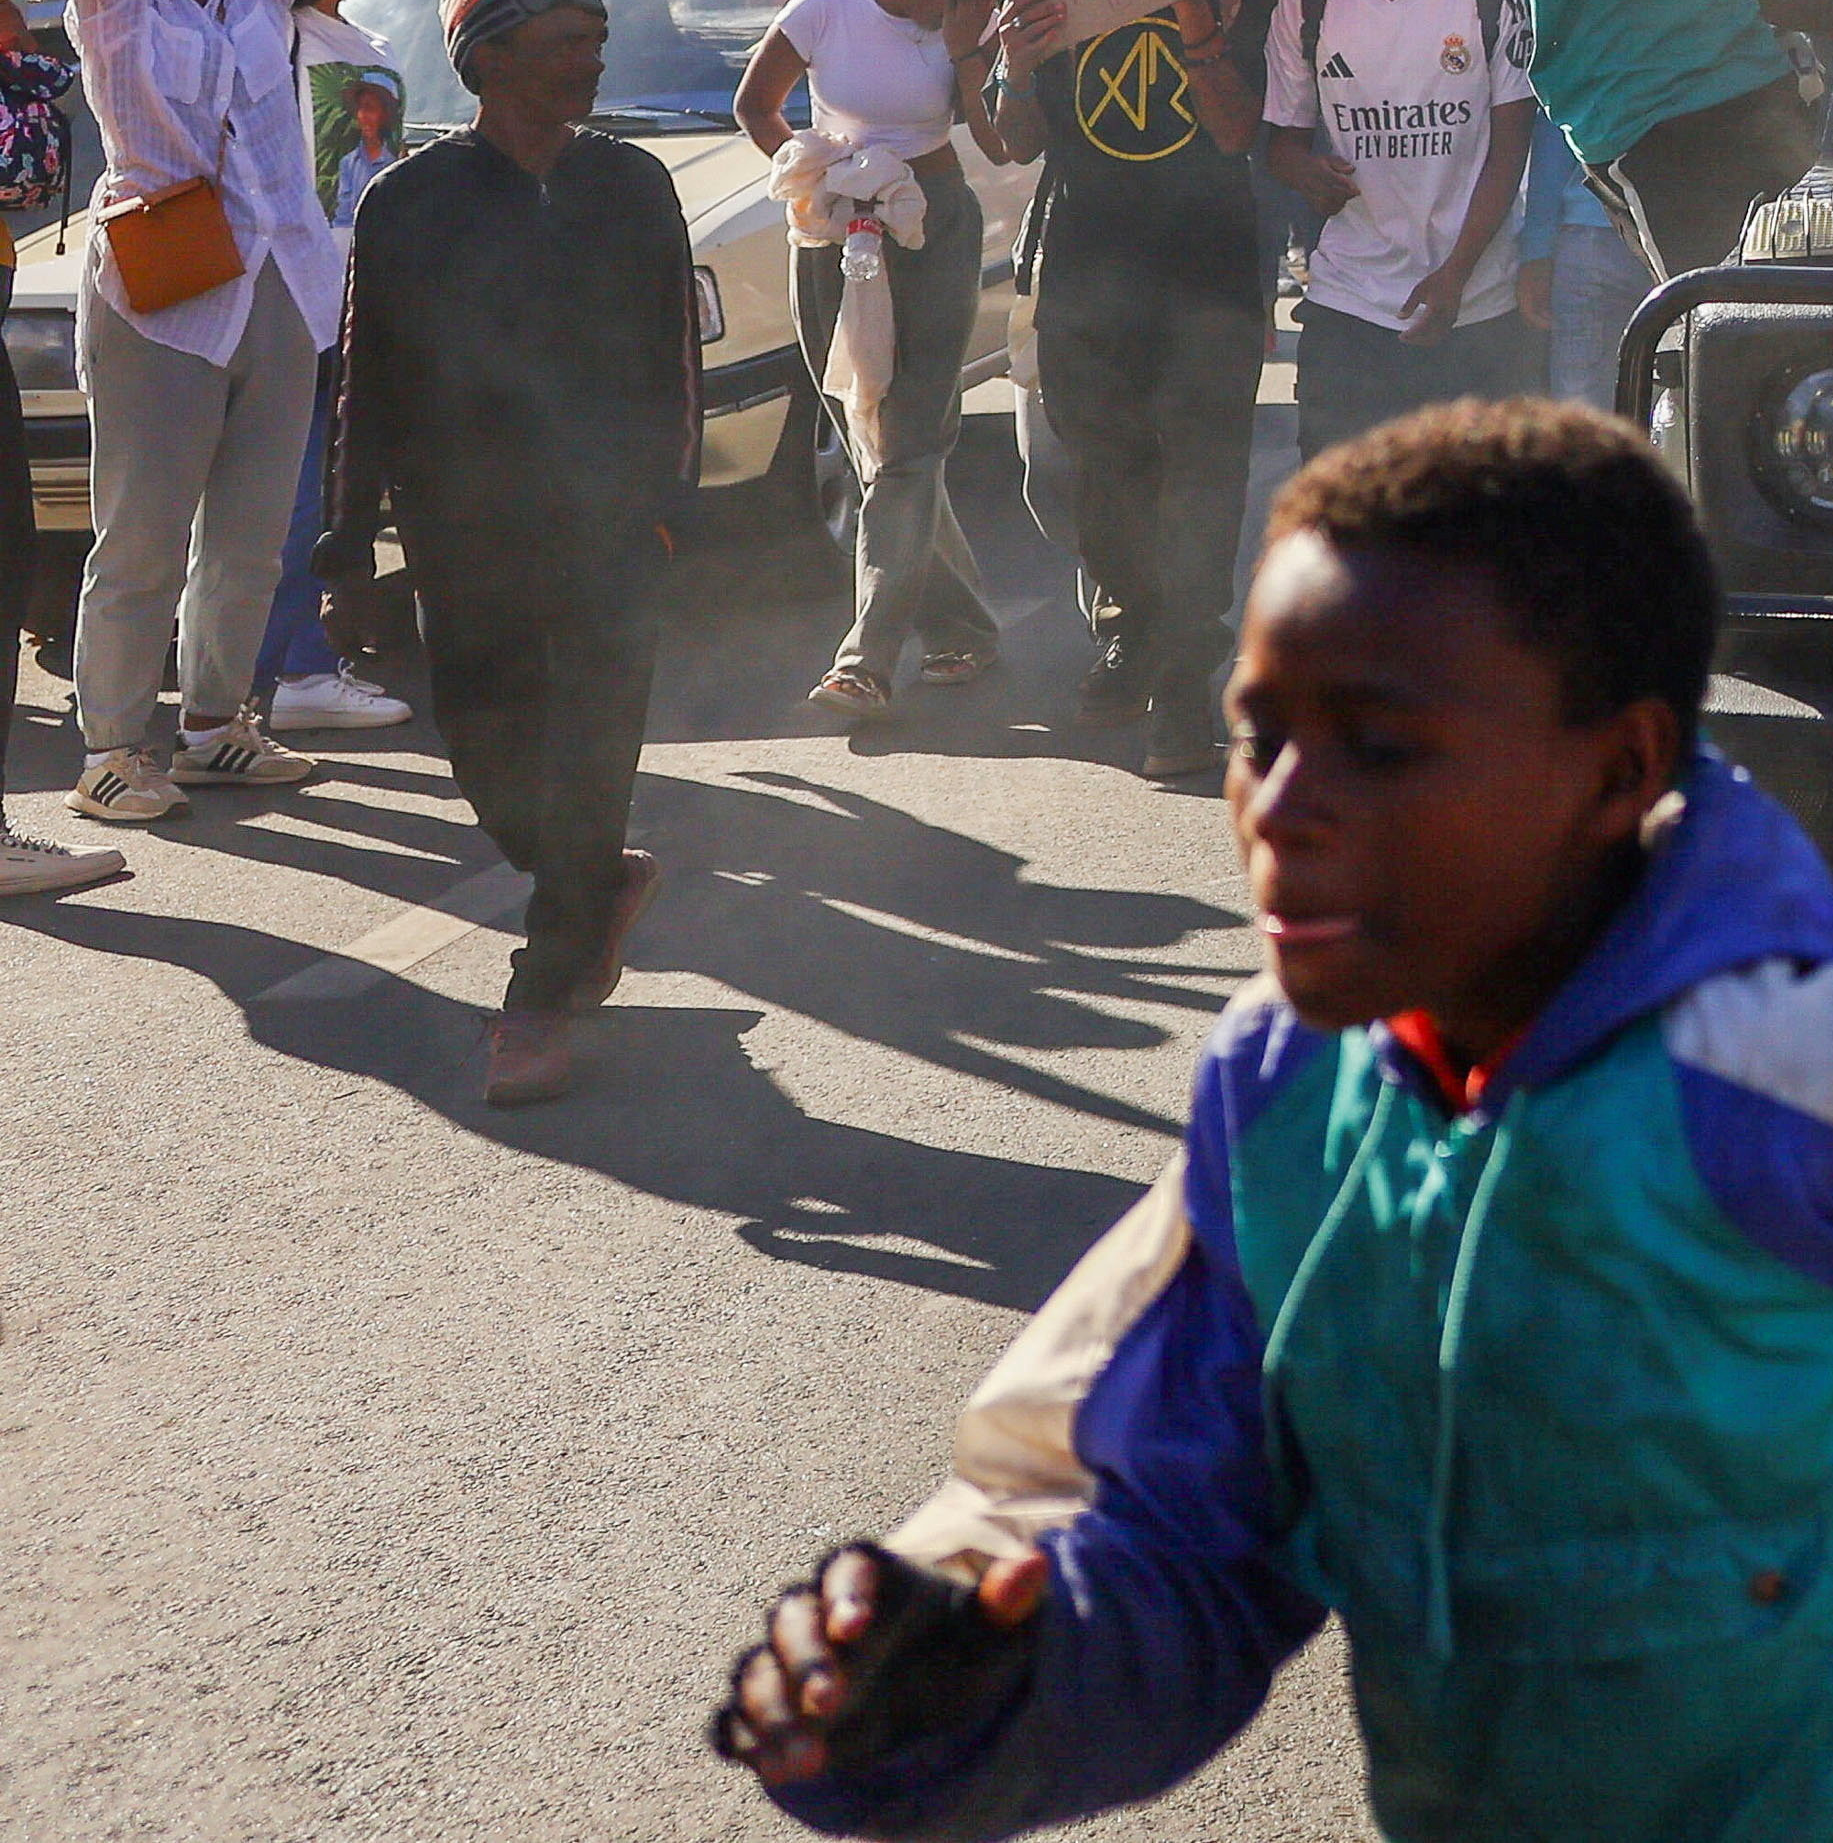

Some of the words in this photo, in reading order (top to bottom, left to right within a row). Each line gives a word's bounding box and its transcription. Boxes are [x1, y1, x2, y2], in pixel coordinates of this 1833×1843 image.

[1332, 99, 1472, 133] Emirates
[1355, 135, 1381, 161] FLY
[1387, 131, 1453, 159] BETTER
